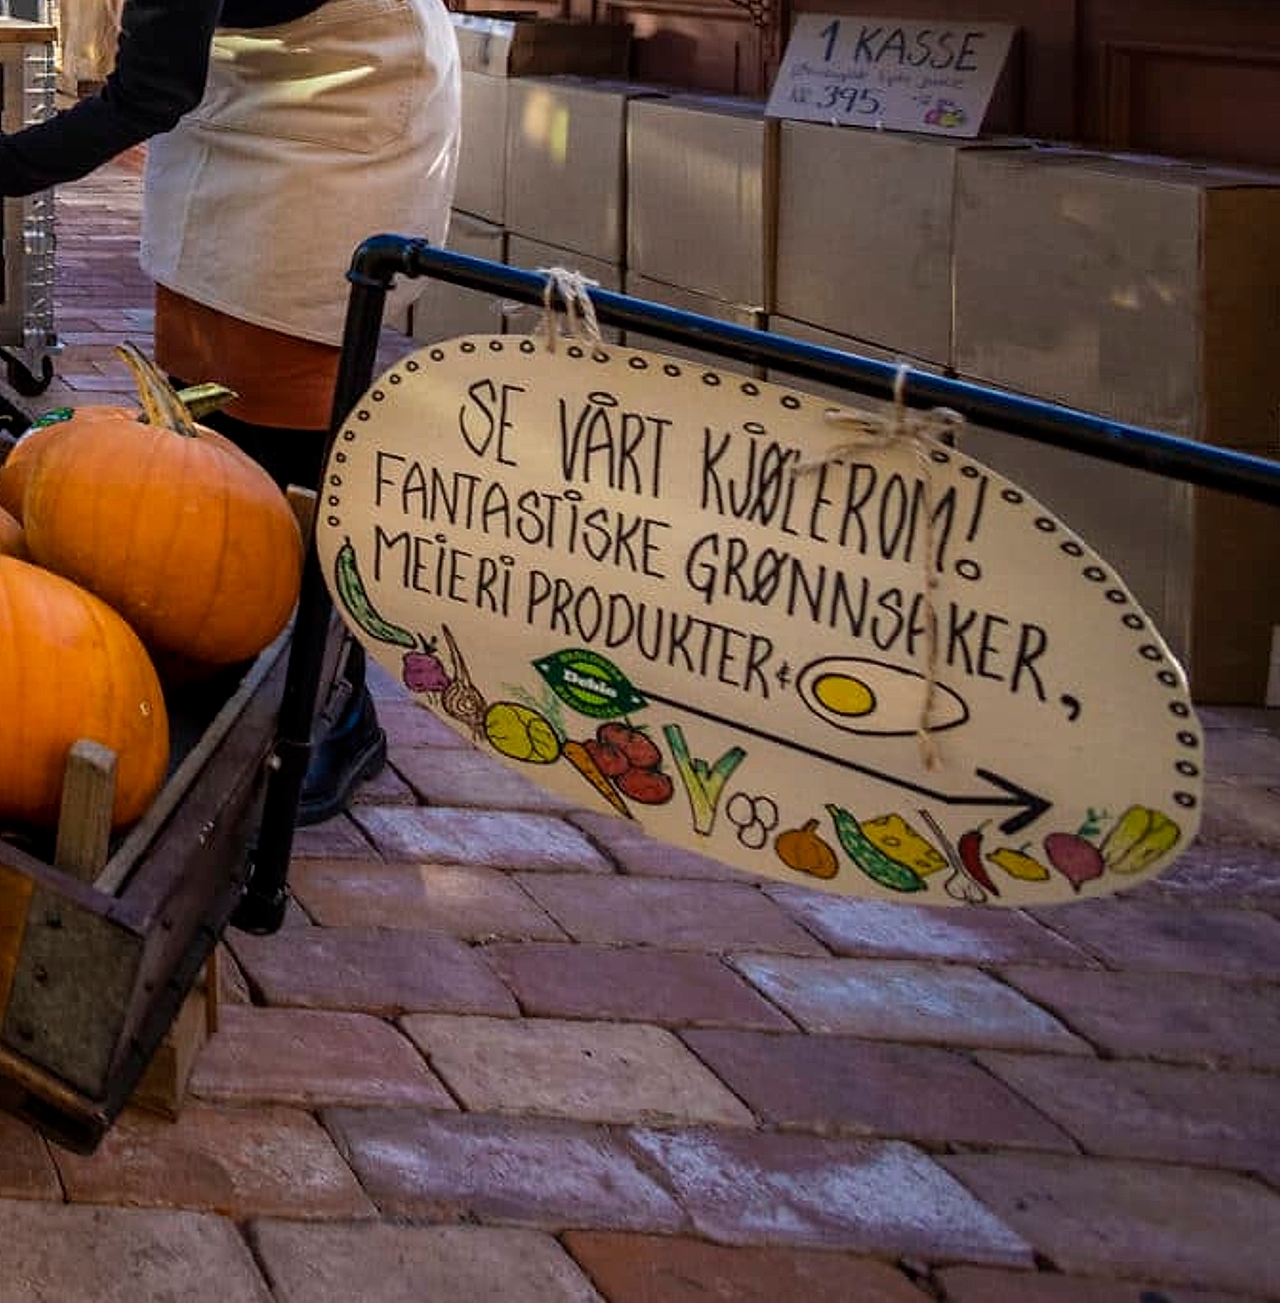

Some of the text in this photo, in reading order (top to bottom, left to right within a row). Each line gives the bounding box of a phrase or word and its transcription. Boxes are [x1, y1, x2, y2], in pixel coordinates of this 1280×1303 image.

[819, 19, 987, 73] 1 KASSE
[373, 453, 671, 582] FANTASTISKE
[458, 377, 989, 582] SE VÅRT KJØLEROM!
[372, 524, 516, 615] MEIERI
[526, 570, 774, 700] PRODUKTER
